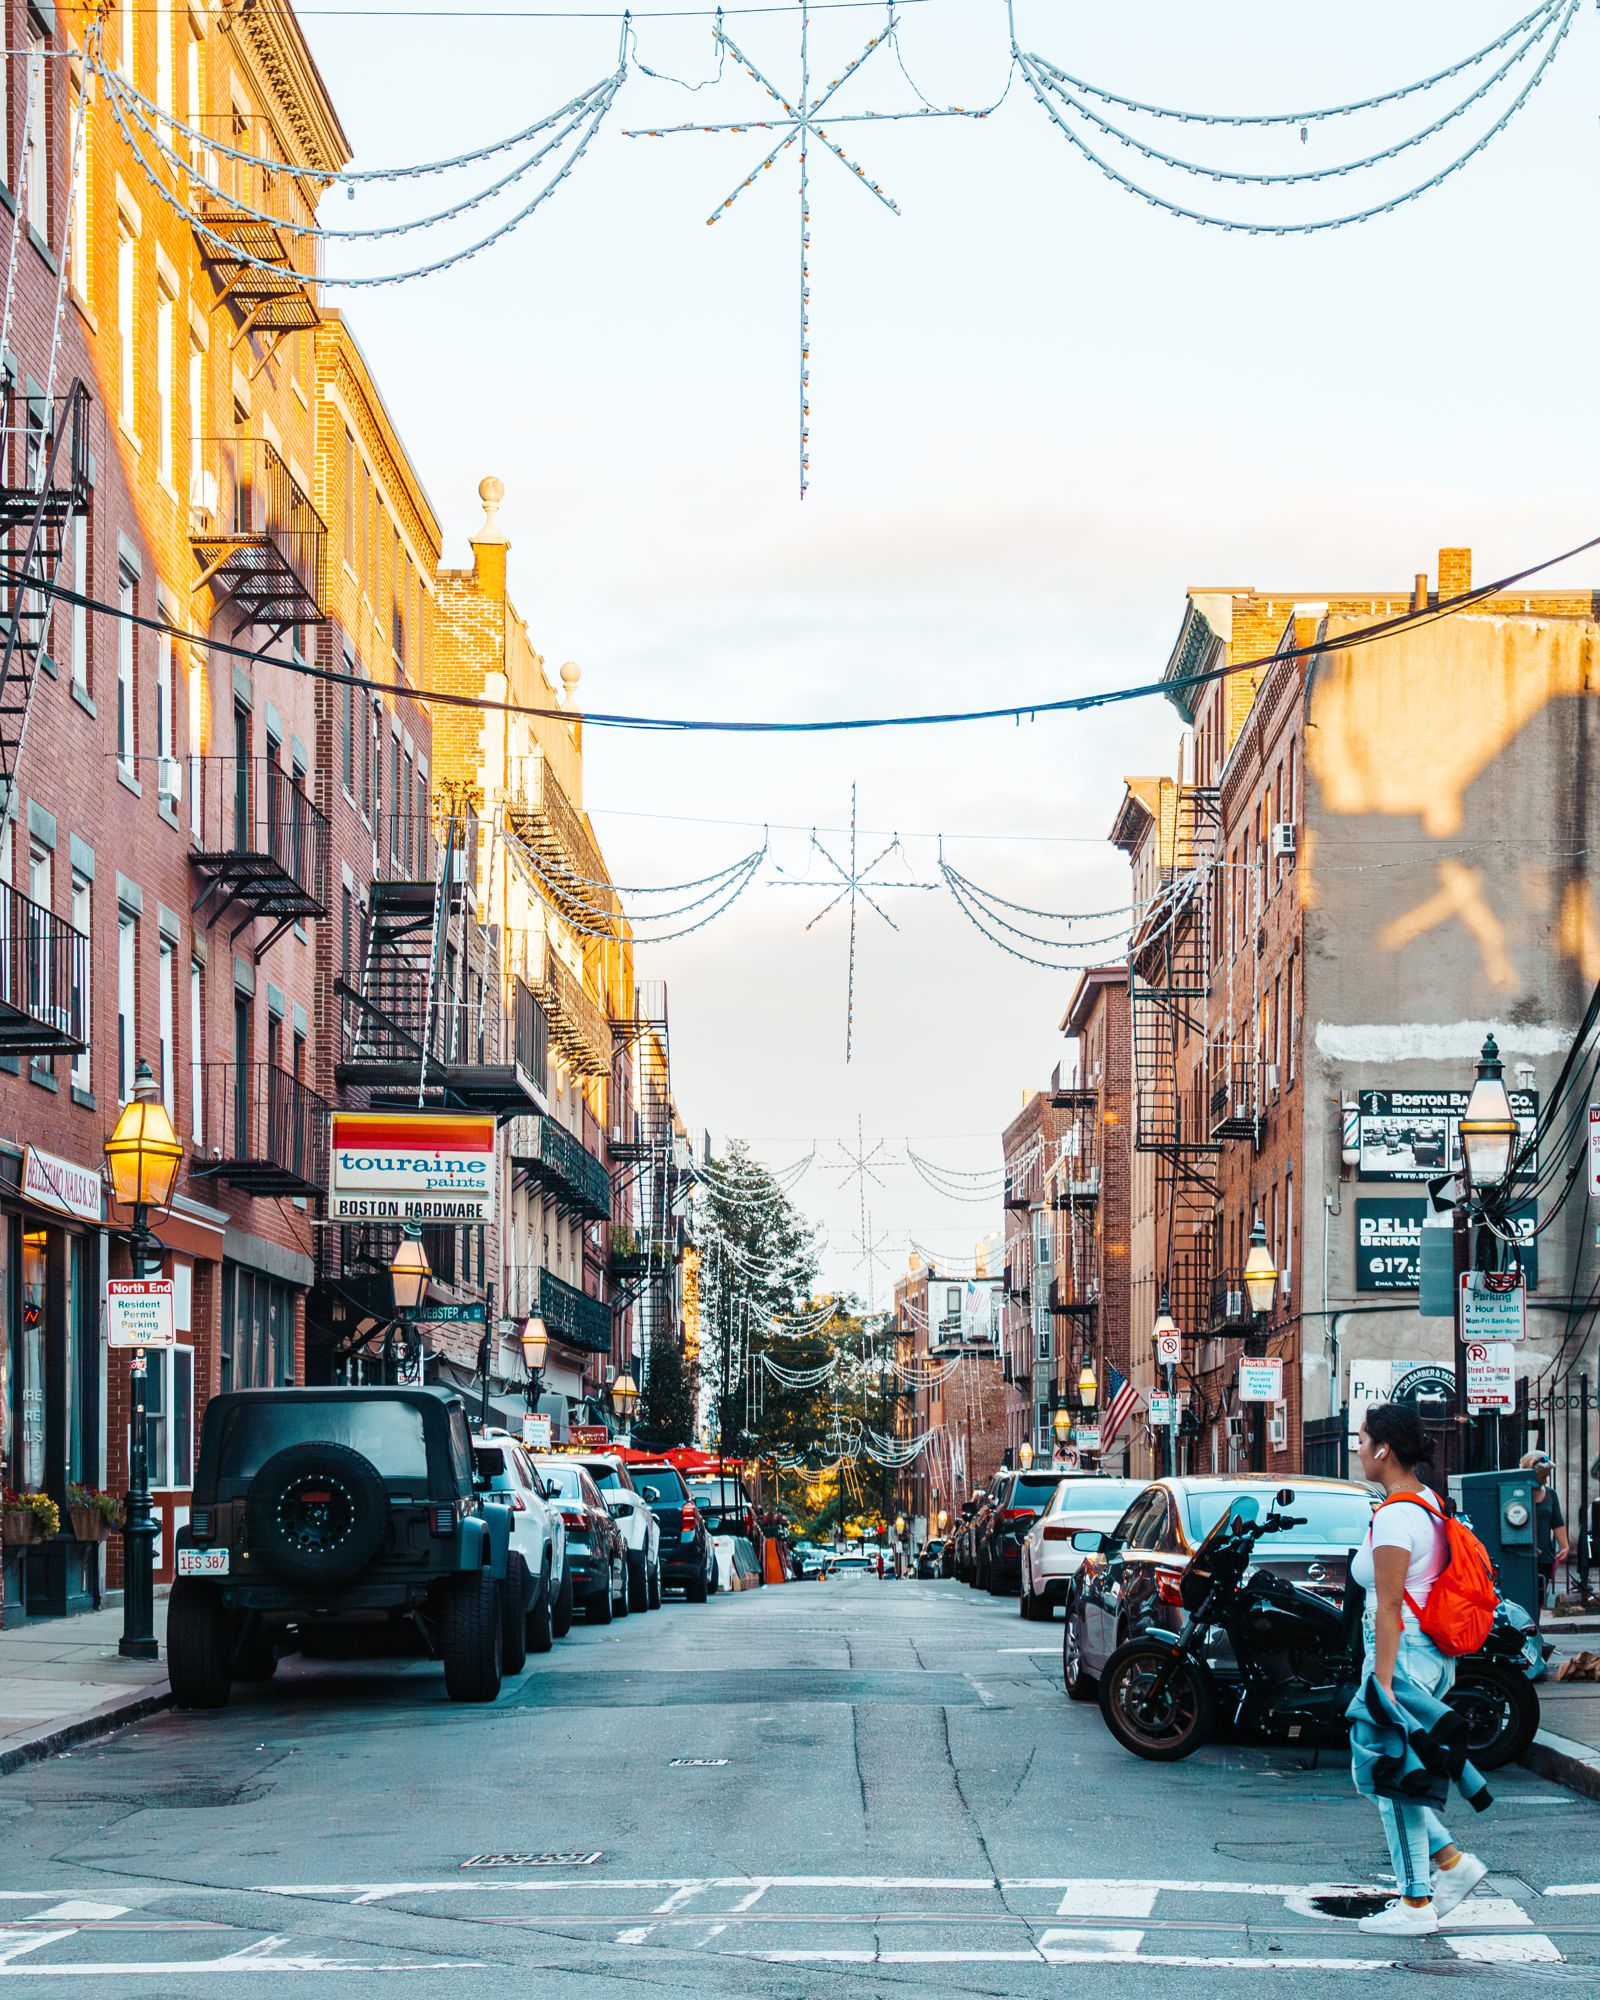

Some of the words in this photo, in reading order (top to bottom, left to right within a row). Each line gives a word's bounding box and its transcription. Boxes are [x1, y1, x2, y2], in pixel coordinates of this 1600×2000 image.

[1392, 1094, 1448, 1106] BOSTON
[1432, 1107, 1457, 1115] BOSTON,
[339, 1151, 487, 1174] touraine
[27, 1156, 64, 1197] BELLISSIMO
[64, 1170, 82, 1204] NAILS
[88, 1178, 99, 1211] SPA
[426, 1173, 486, 1190] paints
[339, 1200, 399, 1217] BOSTON
[405, 1201, 483, 1218] HARDWARE
[113, 1283, 145, 1294] North
[149, 1282, 171, 1293] End
[1473, 1292, 1512, 1303] Parking
[118, 1300, 160, 1309] Resident
[1465, 1304, 1471, 1313] 2
[1475, 1304, 1495, 1313] Hour
[1500, 1305, 1519, 1313] Limit
[124, 1310, 156, 1319] Permit
[420, 1306, 460, 1320] WEBSTER
[462, 1310, 470, 1319] PL
[121, 1320, 159, 1332] Parking
[1244, 1359, 1265, 1367] North
[1407, 1369, 1435, 1383] BARBER
[1467, 1366, 1485, 1374] Street
[1486, 1366, 1510, 1374] Cleaning
[1354, 1382, 1392, 1400] Priv
[1470, 1396, 1484, 1404] Tow
[1485, 1396, 1503, 1404] Zone
[181, 1556, 202, 1570] 1ES
[205, 1555, 226, 1569] 387
